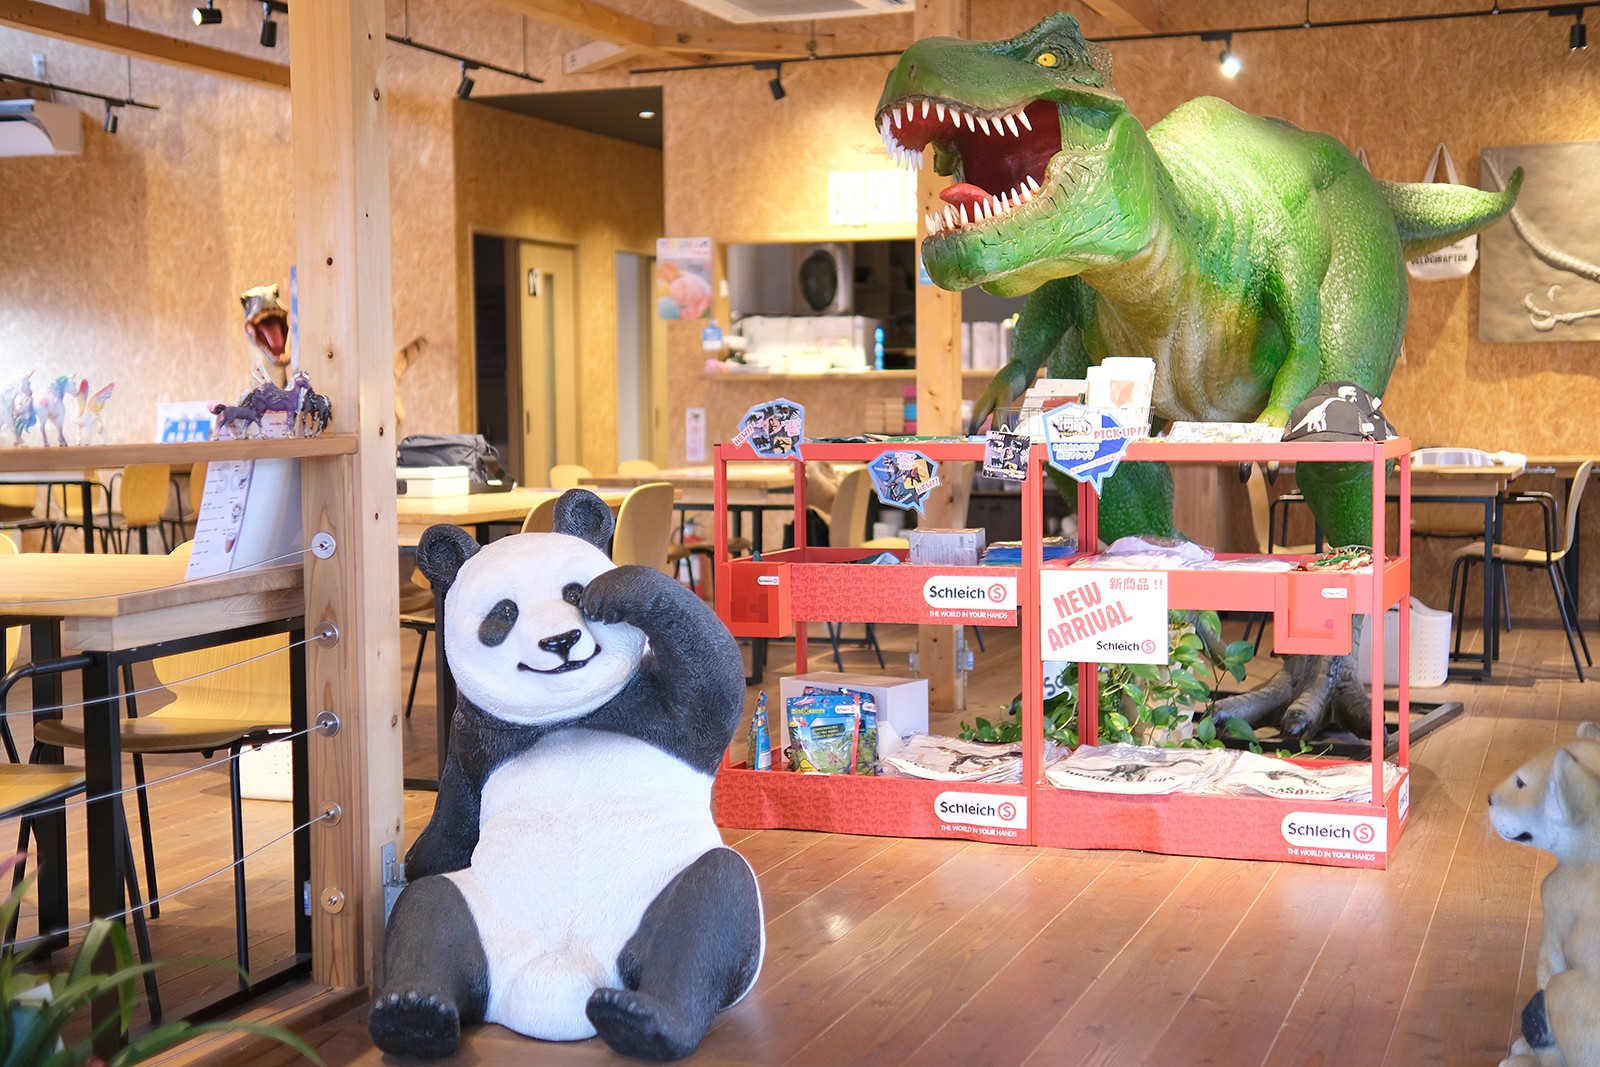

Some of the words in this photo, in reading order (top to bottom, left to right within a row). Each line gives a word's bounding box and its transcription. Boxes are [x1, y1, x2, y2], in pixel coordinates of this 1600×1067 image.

[732, 425, 753, 445] NEW!!
[1093, 428, 1121, 440] PICK
[1122, 426, 1147, 438] UP!!
[916, 478, 939, 493] NEW!!
[929, 585, 986, 599] Schleich
[1053, 581, 1102, 619] NEW
[1047, 601, 1134, 652] ARRIVAL
[1096, 640, 1140, 651] Schleich
[940, 801, 995, 817] Schleich
[952, 825, 972, 833] WORLD
[996, 830, 1017, 838] HANDS
[1288, 822, 1351, 839] Schleich
[1287, 848, 1299, 856] THE
[1300, 849, 1323, 858] WORLD
[1324, 850, 1331, 858] IN
[1332, 851, 1351, 860] YOUR
[1352, 853, 1375, 862] HANDS
